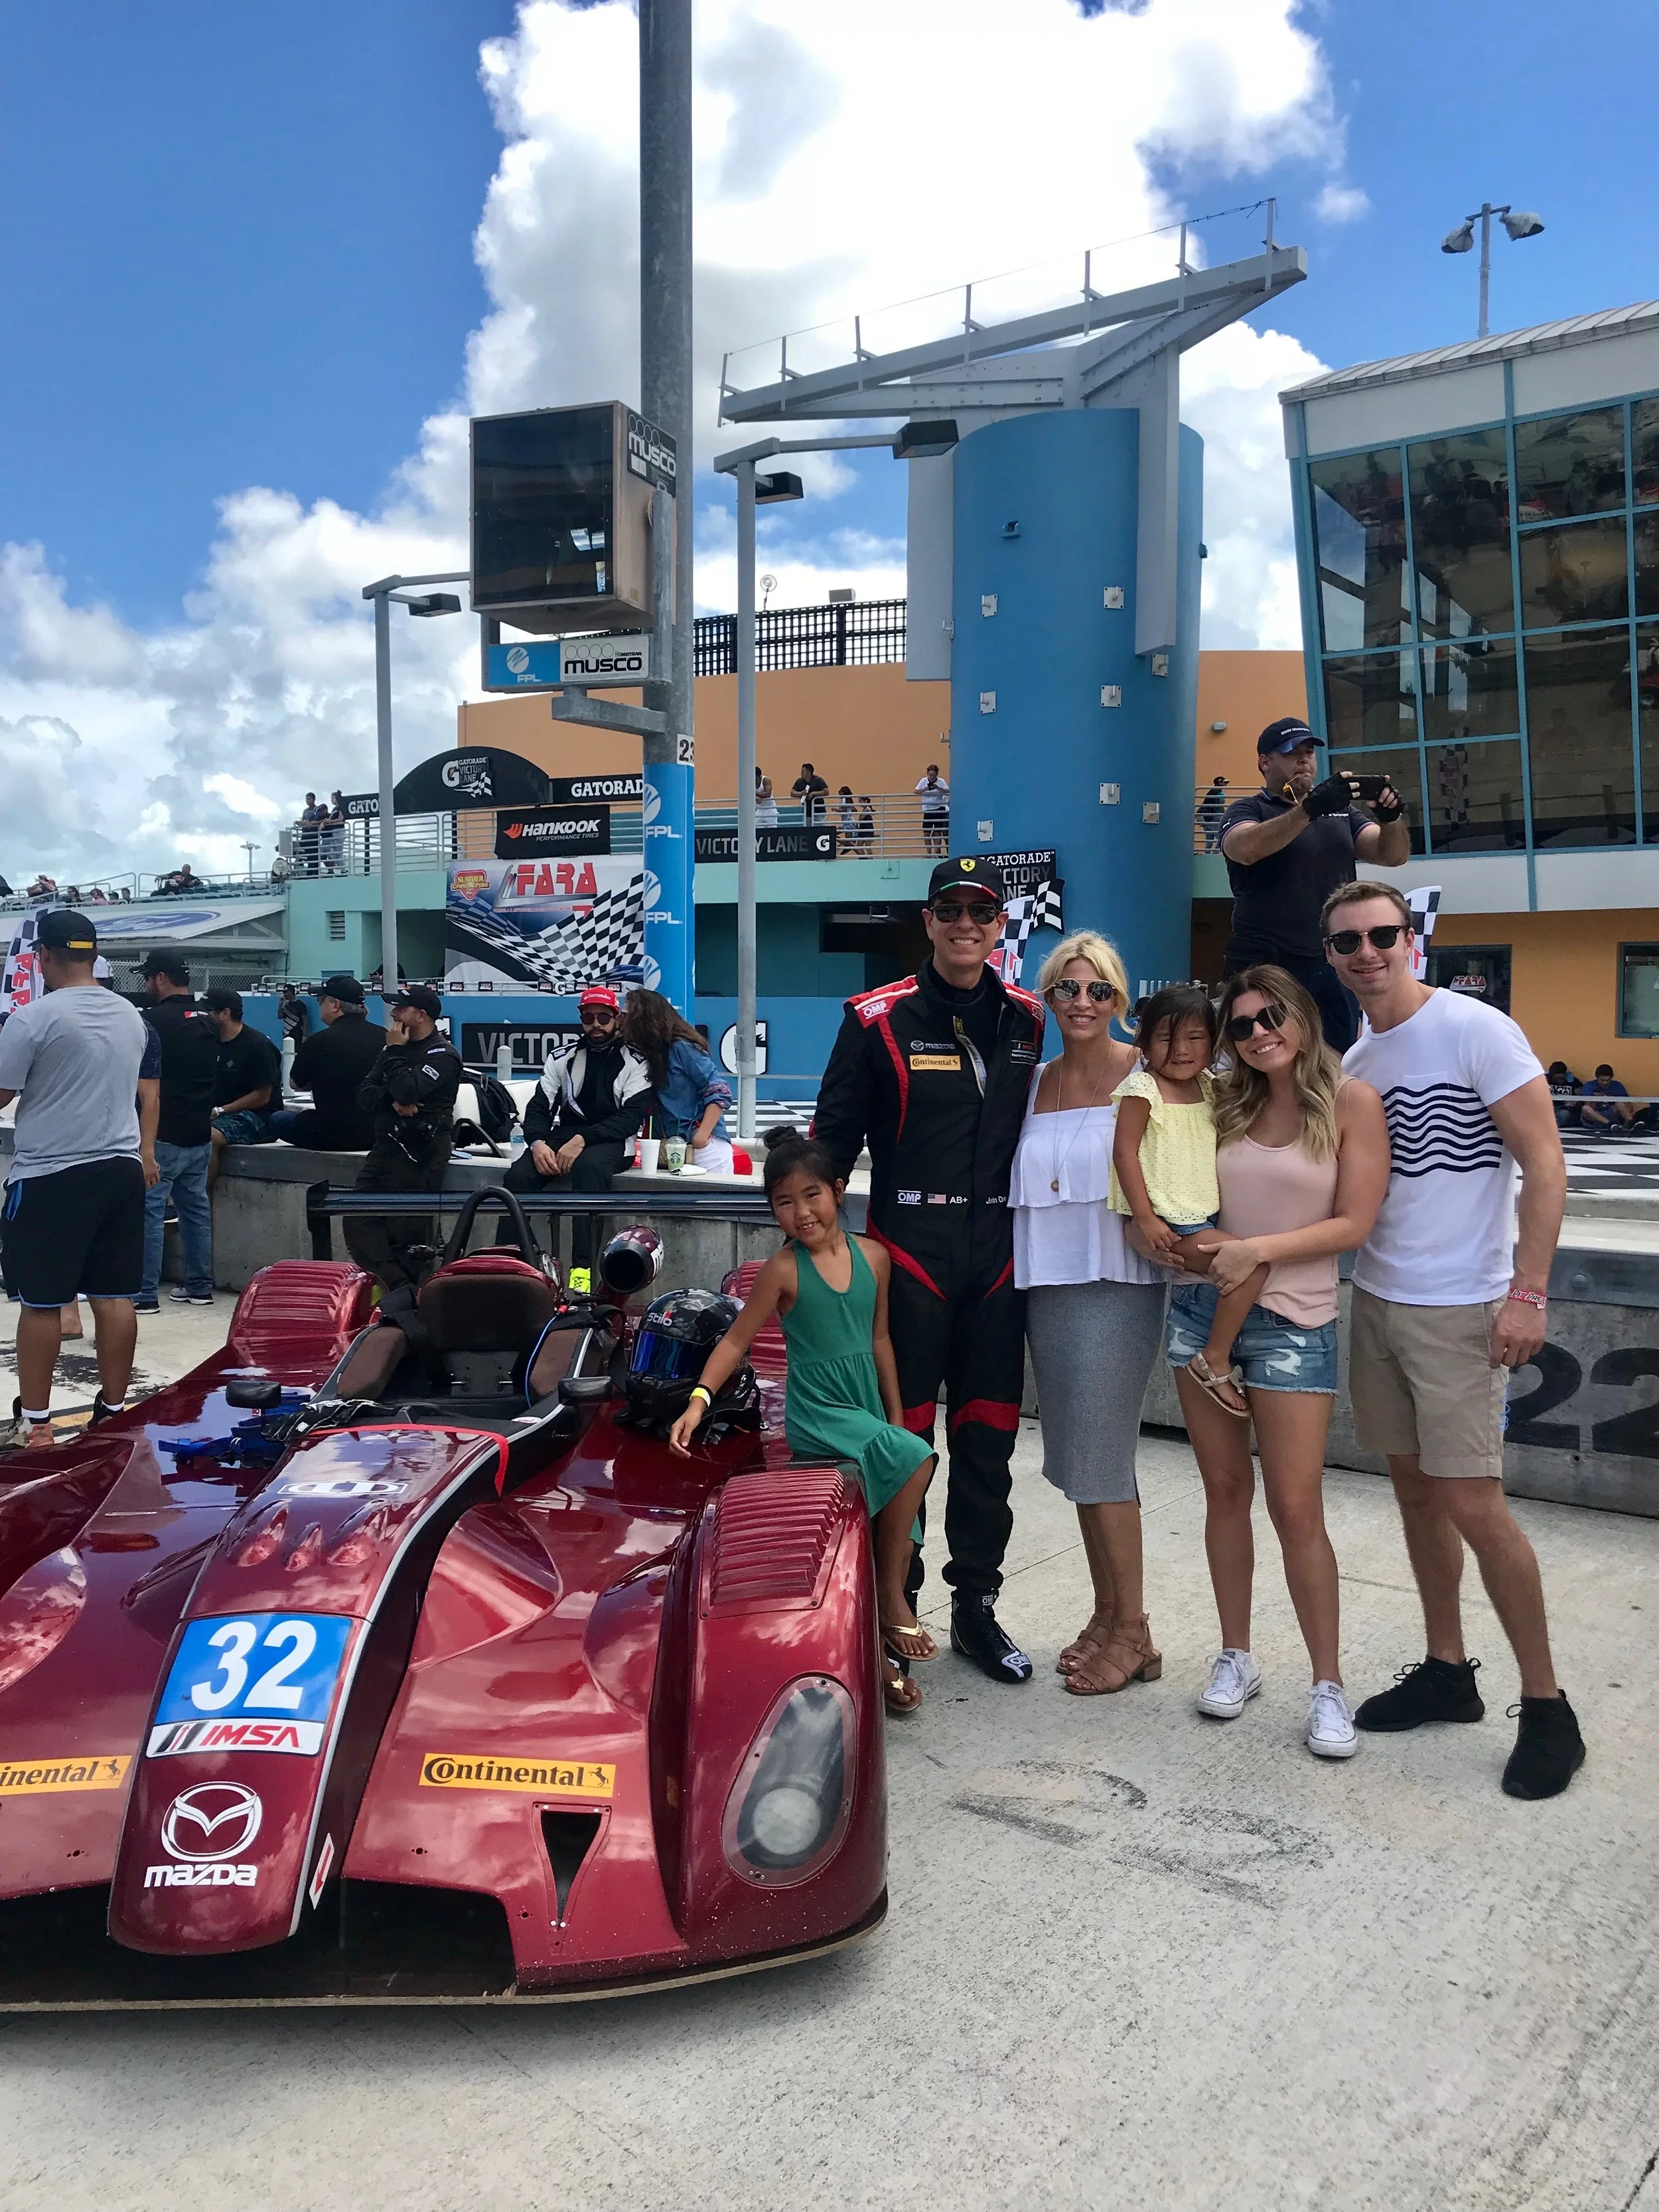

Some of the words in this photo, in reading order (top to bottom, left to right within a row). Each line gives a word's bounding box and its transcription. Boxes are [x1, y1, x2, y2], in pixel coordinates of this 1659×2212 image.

[565, 657, 642, 674] MUSCO
[442, 760, 460, 787] G
[460, 774, 476, 783] LANE
[571, 779, 643, 797] GATORAD
[348, 798, 380, 815] GATO
[536, 833, 580, 842] PERFORMANCE
[646, 826, 680, 838] FPL
[696, 836, 763, 855] VICTOY
[767, 835, 809, 853] LANE
[816, 835, 830, 851] G
[517, 863, 597, 896] FARA
[999, 865, 1051, 885] CTORY
[646, 912, 680, 924] FPL
[863, 1001, 887, 1017] OMP
[478, 1033, 585, 1064] VCTO
[912, 1058, 952, 1067] Continental
[898, 1192, 921, 1202] OMP
[1512, 1290, 1526, 1299] PIT
[1527, 1293, 1542, 1303] PAS
[646, 1310, 672, 1326] Stilo
[191, 1619, 317, 1711] 32
[200, 1725, 299, 1748] IMSA
[424, 1757, 585, 1787] Continental
[143, 1864, 258, 1888] mazda
